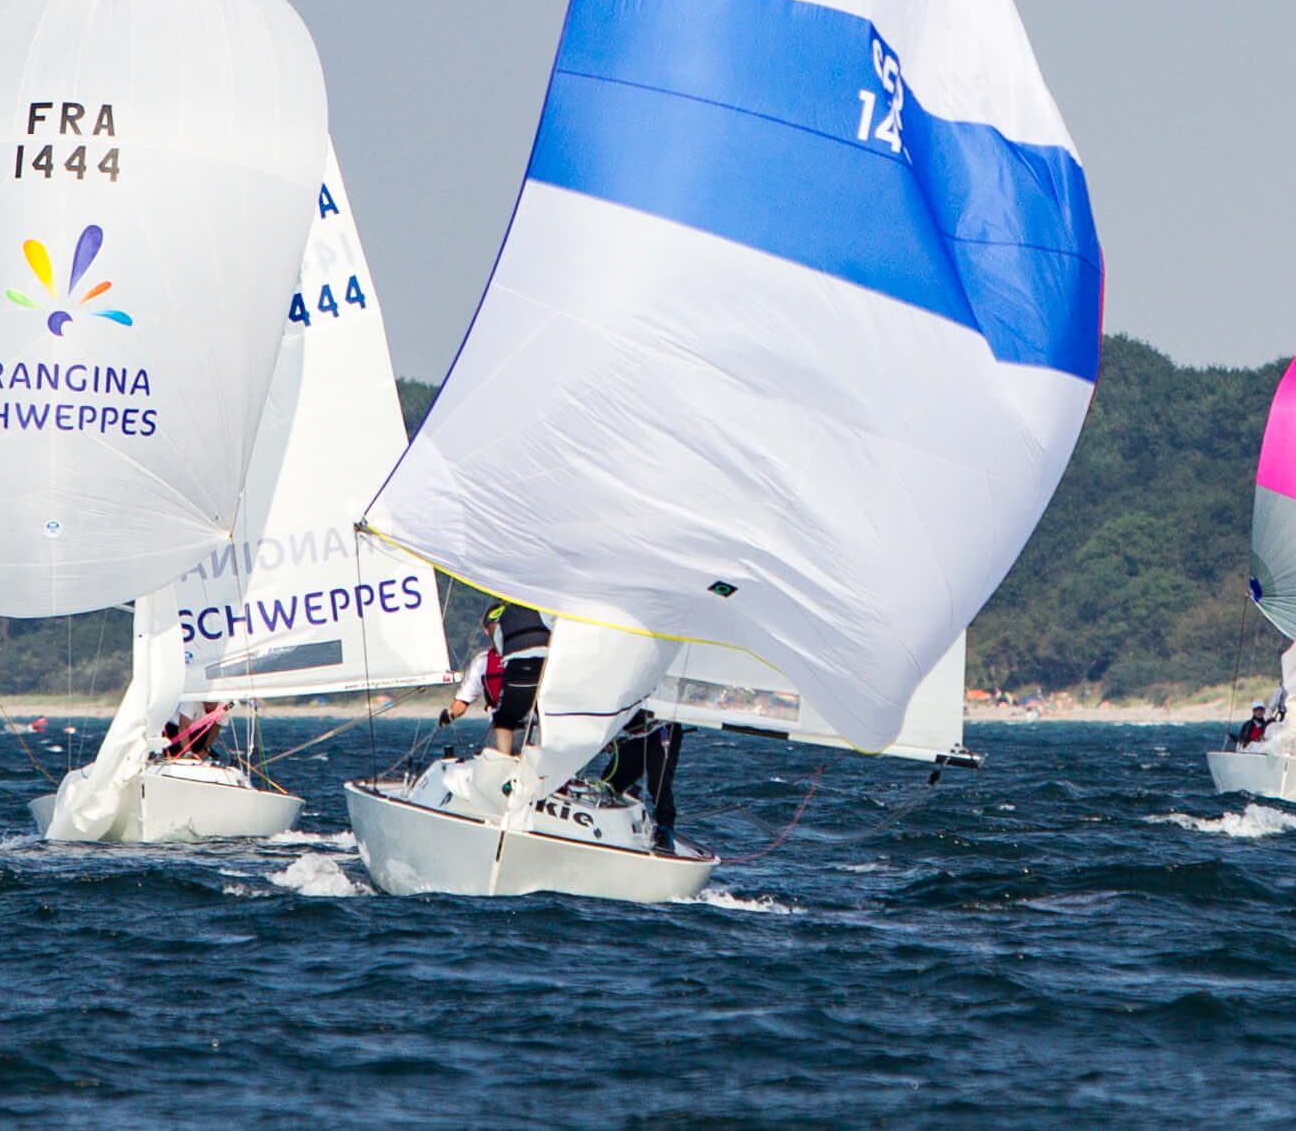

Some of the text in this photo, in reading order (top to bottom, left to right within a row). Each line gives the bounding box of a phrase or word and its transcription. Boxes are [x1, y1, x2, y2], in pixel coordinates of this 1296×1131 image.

[27, 101, 116, 137] FRA
[14, 144, 121, 183] 1444
[288, 273, 367, 328] 444
[178, 574, 423, 644] SCHWEPPES
